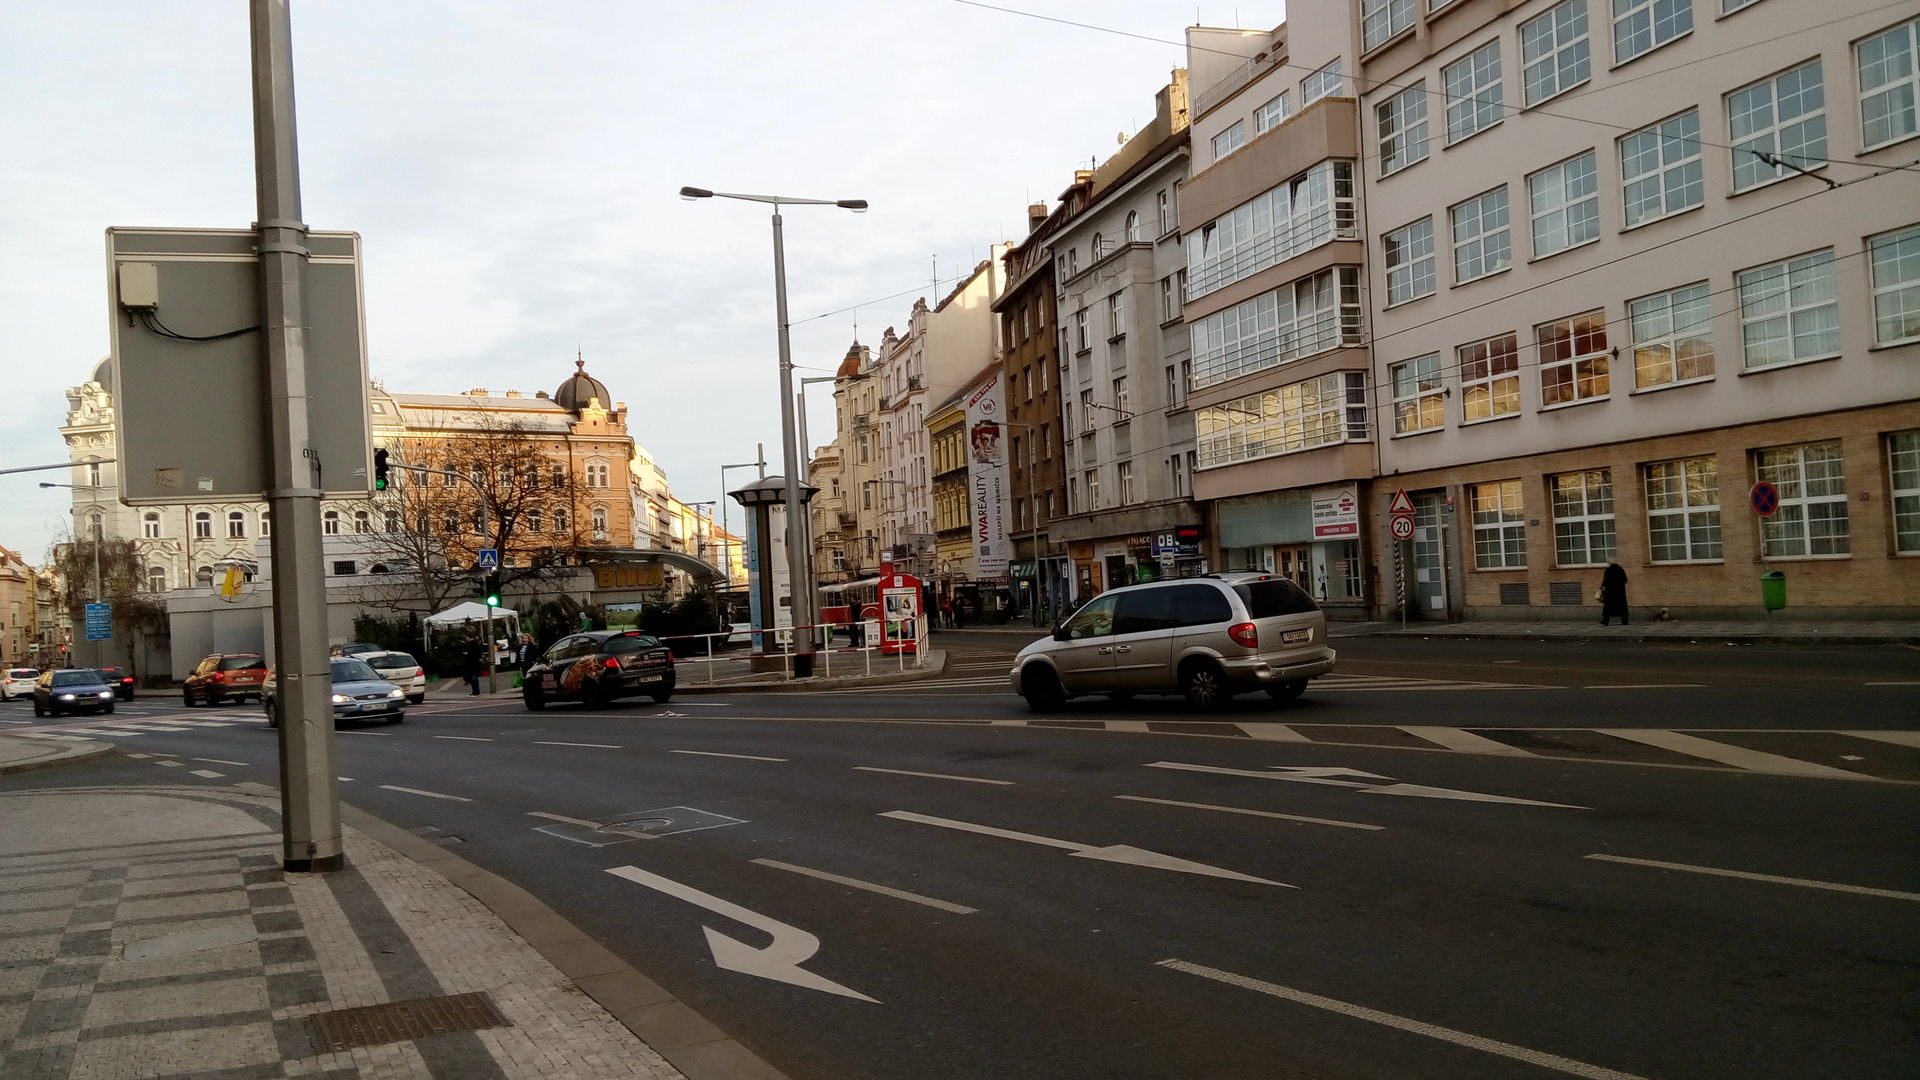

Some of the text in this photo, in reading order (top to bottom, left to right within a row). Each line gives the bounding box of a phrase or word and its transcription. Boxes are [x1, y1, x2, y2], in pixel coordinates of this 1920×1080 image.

[976, 475, 988, 543] VIVAREALITY
[1396, 521, 1409, 533] 20
[598, 569, 662, 587] BILLA
